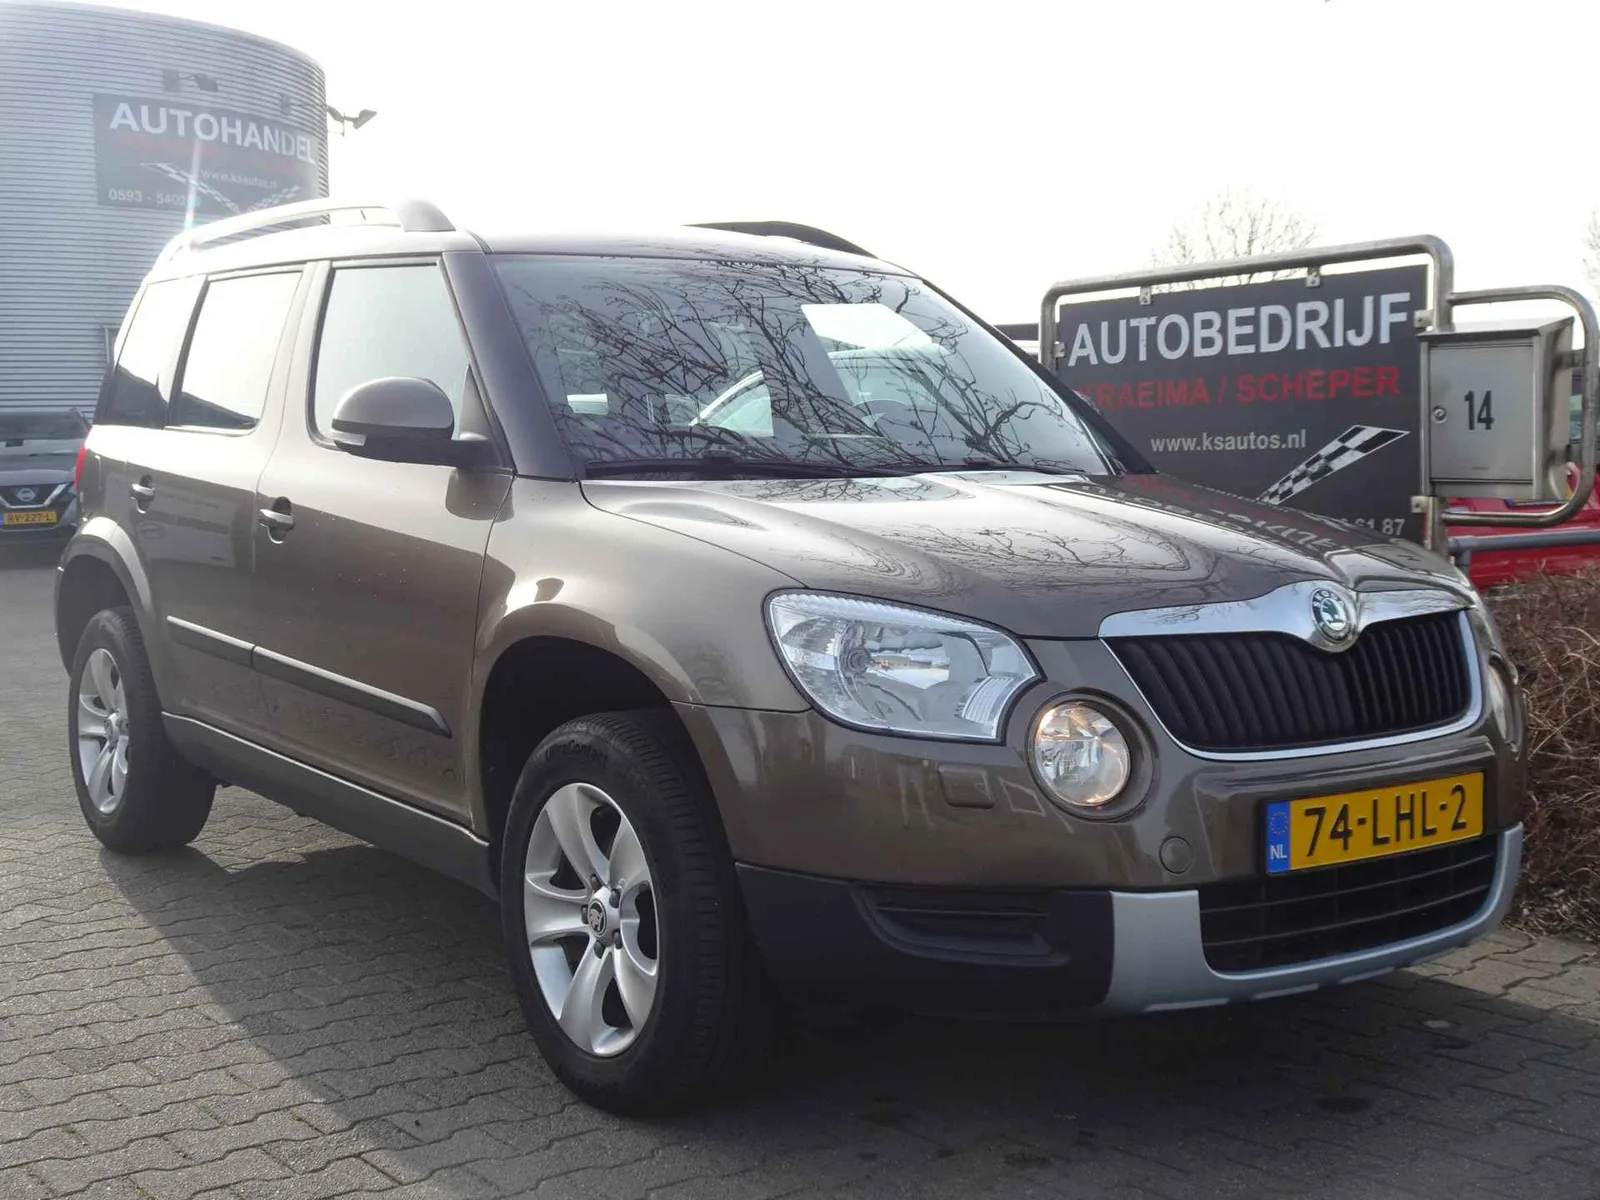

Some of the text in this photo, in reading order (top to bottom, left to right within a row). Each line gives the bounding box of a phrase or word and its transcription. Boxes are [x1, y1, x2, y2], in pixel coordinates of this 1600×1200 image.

[109, 102, 316, 164] AUTOHANDEL
[1068, 292, 1411, 367] AUTOBEDRIJF
[1236, 366, 1401, 402] SCHEPER
[1464, 390, 1495, 431] 14
[1150, 429, 1307, 452] www.ksautos.nl
[1382, 518, 1405, 536] 87
[1304, 784, 1467, 857] 74-LHL-2
[1269, 844, 1288, 860] NL
